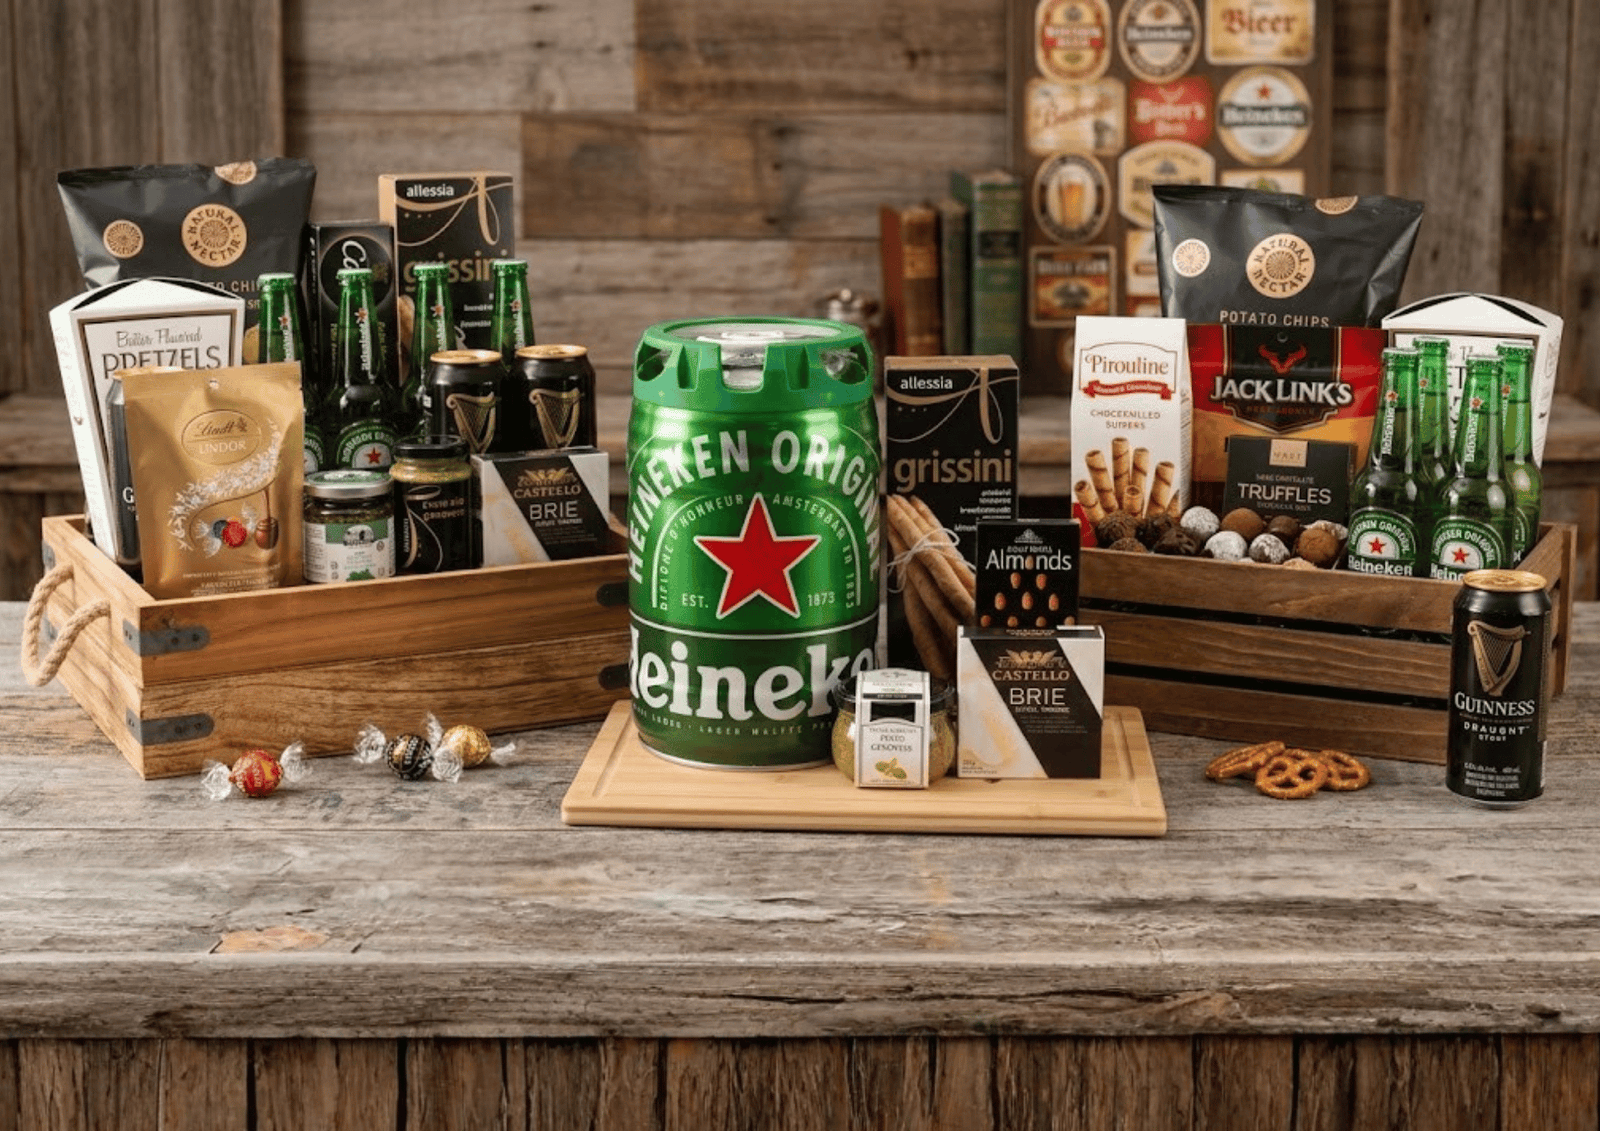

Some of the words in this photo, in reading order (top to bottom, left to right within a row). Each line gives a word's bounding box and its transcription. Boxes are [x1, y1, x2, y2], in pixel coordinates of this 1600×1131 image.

[406, 184, 455, 198] allessia
[189, 238, 242, 261] NECTAR
[1252, 266, 1308, 293] NECTAR
[1220, 309, 1277, 326] POTATO
[1283, 314, 1331, 328] CHIPS
[1085, 354, 1170, 376] Pirouline
[899, 376, 954, 390] allessia
[1211, 376, 1273, 404] JACK
[1275, 378, 1354, 407] LINK'S
[894, 449, 1012, 493] grissini
[1237, 482, 1333, 505] TRUFFLES
[529, 500, 579, 521] BRIE
[629, 429, 750, 584] HEINEKEN
[808, 591, 836, 607] 1873
[991, 670, 1070, 682] CASTELLO
[1009, 687, 1067, 706] BRIE
[1454, 691, 1536, 717] GUINNESS
